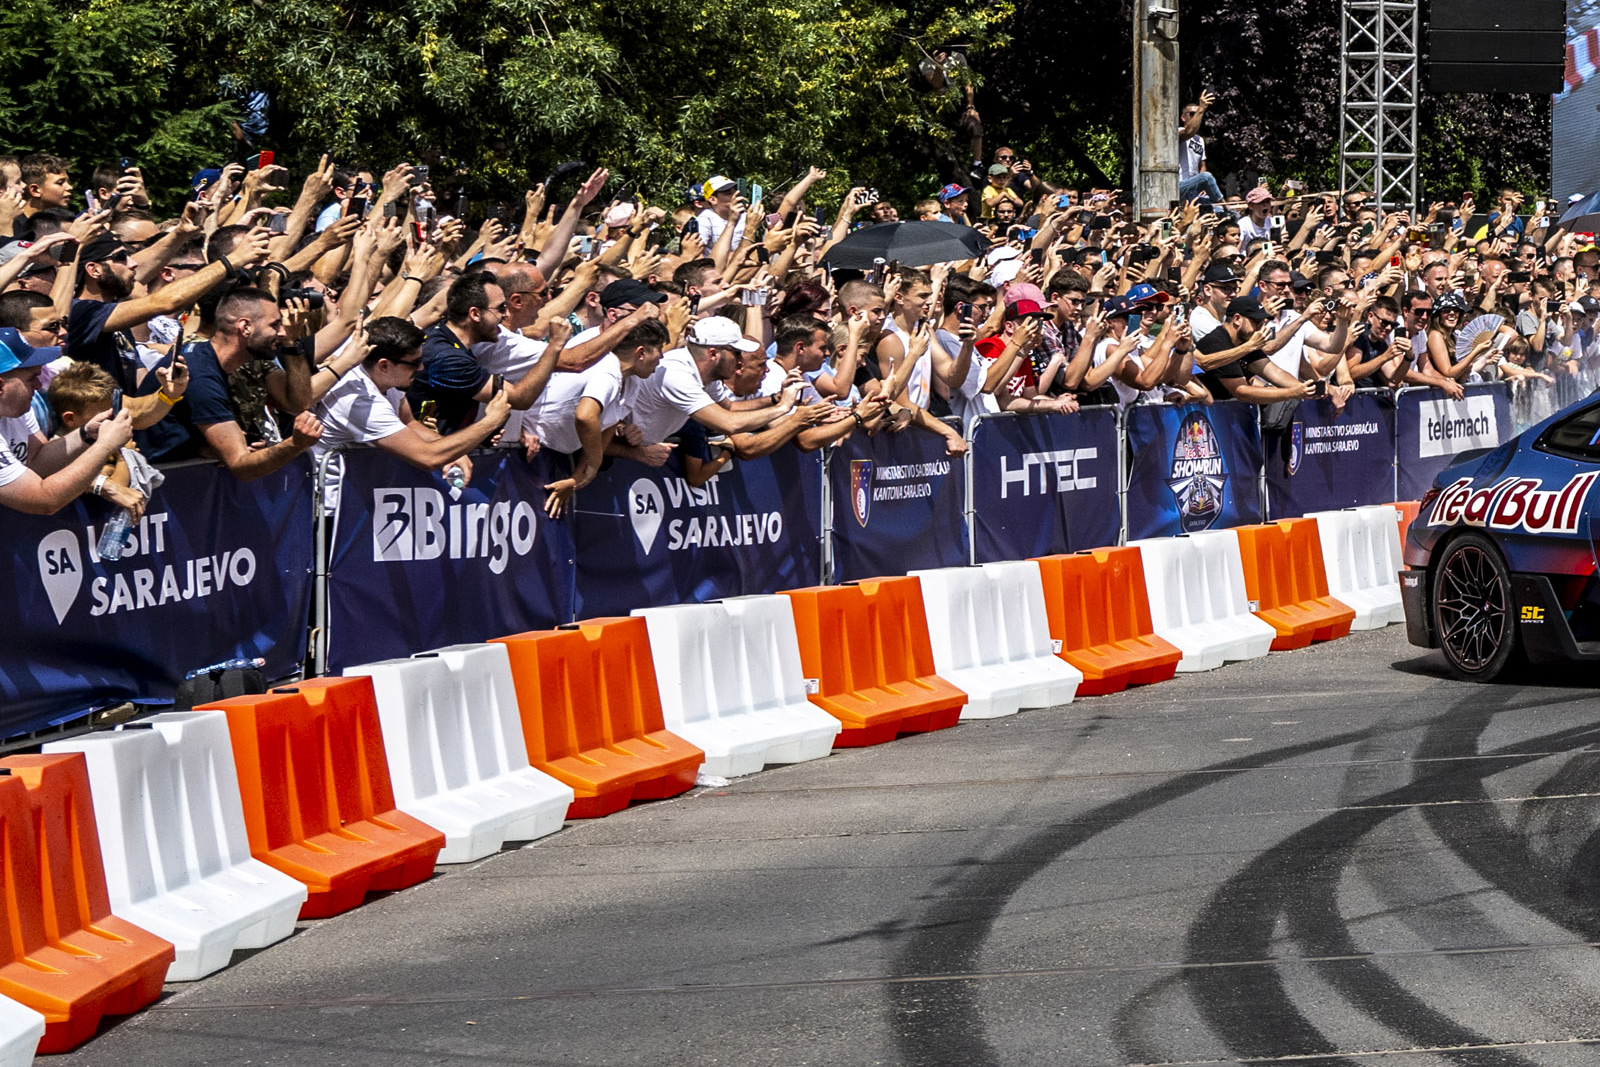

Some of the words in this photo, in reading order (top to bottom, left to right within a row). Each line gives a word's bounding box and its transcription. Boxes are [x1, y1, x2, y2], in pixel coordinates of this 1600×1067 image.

[1305, 424, 1346, 439] MINISTARSTVO
[1345, 421, 1378, 435] SAOBRAĆAJA
[1428, 411, 1489, 441] telemach
[1305, 441, 1331, 455] KANTONA
[1331, 439, 1359, 453] SARAJEVO
[876, 463, 915, 480] MINISTARSTVO
[1001, 447, 1098, 499] HTEC
[1172, 458, 1222, 479] SHOWRUN
[635, 493, 659, 515] SA
[873, 485, 903, 501] KANTONA
[903, 483, 931, 498] SARAJEVO
[1427, 477, 1512, 527] Red
[1489, 471, 1600, 533] Bull
[414, 487, 537, 575] Bingo
[668, 511, 782, 550] SARAJEVO
[45, 547, 77, 575] SA
[90, 547, 256, 617] SARAJEVO
